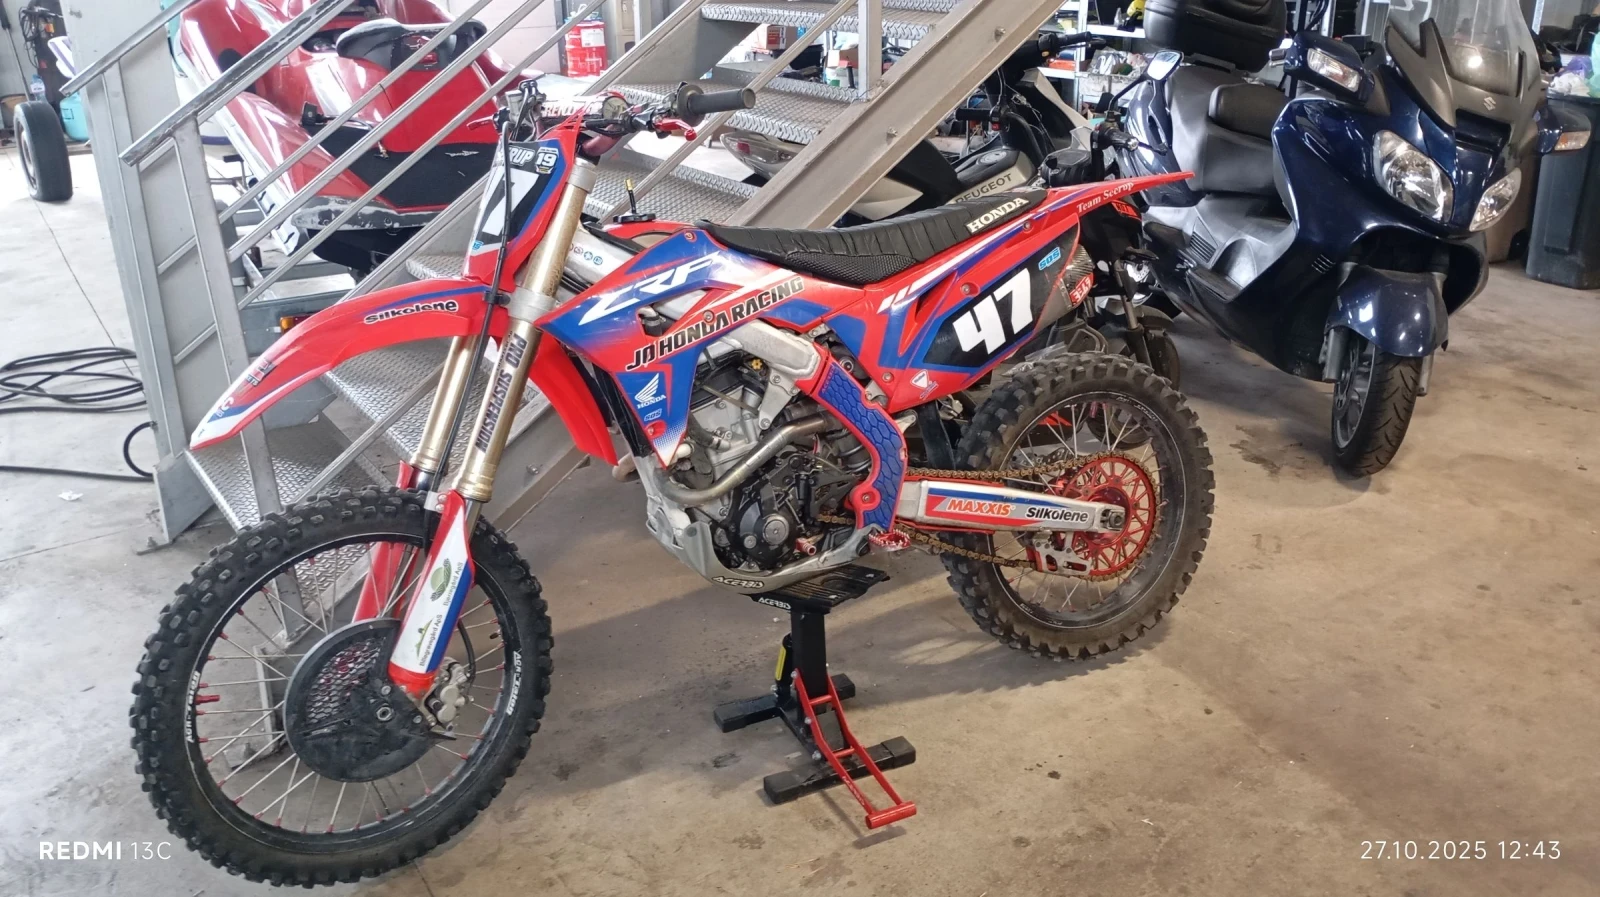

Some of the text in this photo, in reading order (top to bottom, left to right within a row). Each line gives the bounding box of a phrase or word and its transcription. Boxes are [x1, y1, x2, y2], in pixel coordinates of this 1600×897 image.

[536, 152, 557, 167] 19
[966, 197, 1029, 234] HONDA
[1077, 195, 1102, 213] Team
[578, 251, 720, 326] CRF
[364, 299, 459, 324] Silkolene
[657, 310, 730, 358] HONDA
[731, 276, 805, 324] RACING
[952, 268, 1034, 355] 47
[505, 333, 529, 369] PRO
[474, 369, 514, 454] SUSPENSION
[637, 394, 667, 410] HONDA
[945, 498, 1088, 523] MAXXIS Silkolene
[454, 562, 464, 577] ApS
[434, 614, 443, 629] ApS
